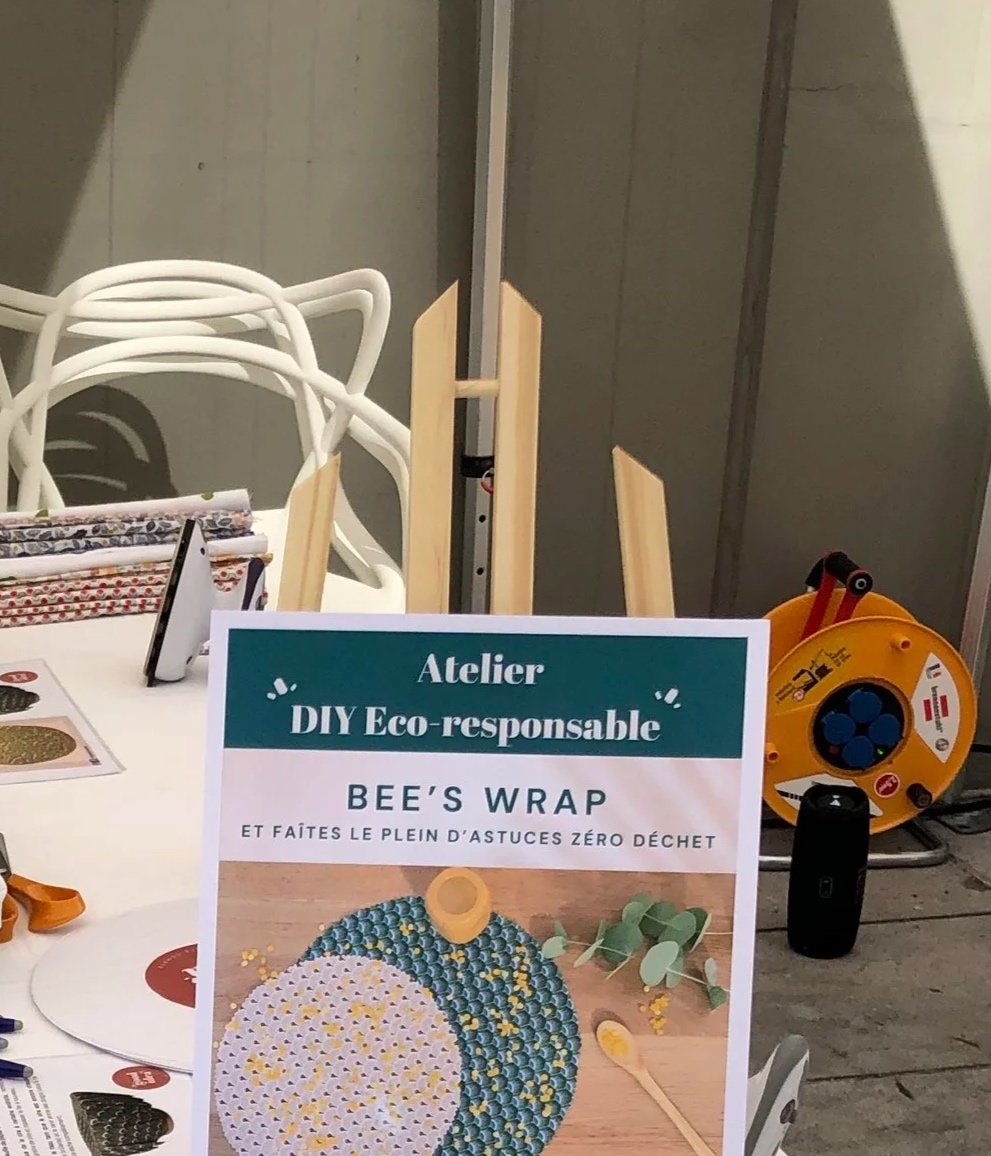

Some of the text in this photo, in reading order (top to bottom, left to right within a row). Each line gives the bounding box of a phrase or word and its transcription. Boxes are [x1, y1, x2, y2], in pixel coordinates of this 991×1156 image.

[417, 652, 545, 686] Atelier
[290, 704, 661, 748] DIY Eco-responsable
[347, 783, 607, 816] BEE'S WRAP
[241, 821, 717, 850] ET FAÎTES LE PLEIN D'ASTUCES ZÉRO DÉCHET
